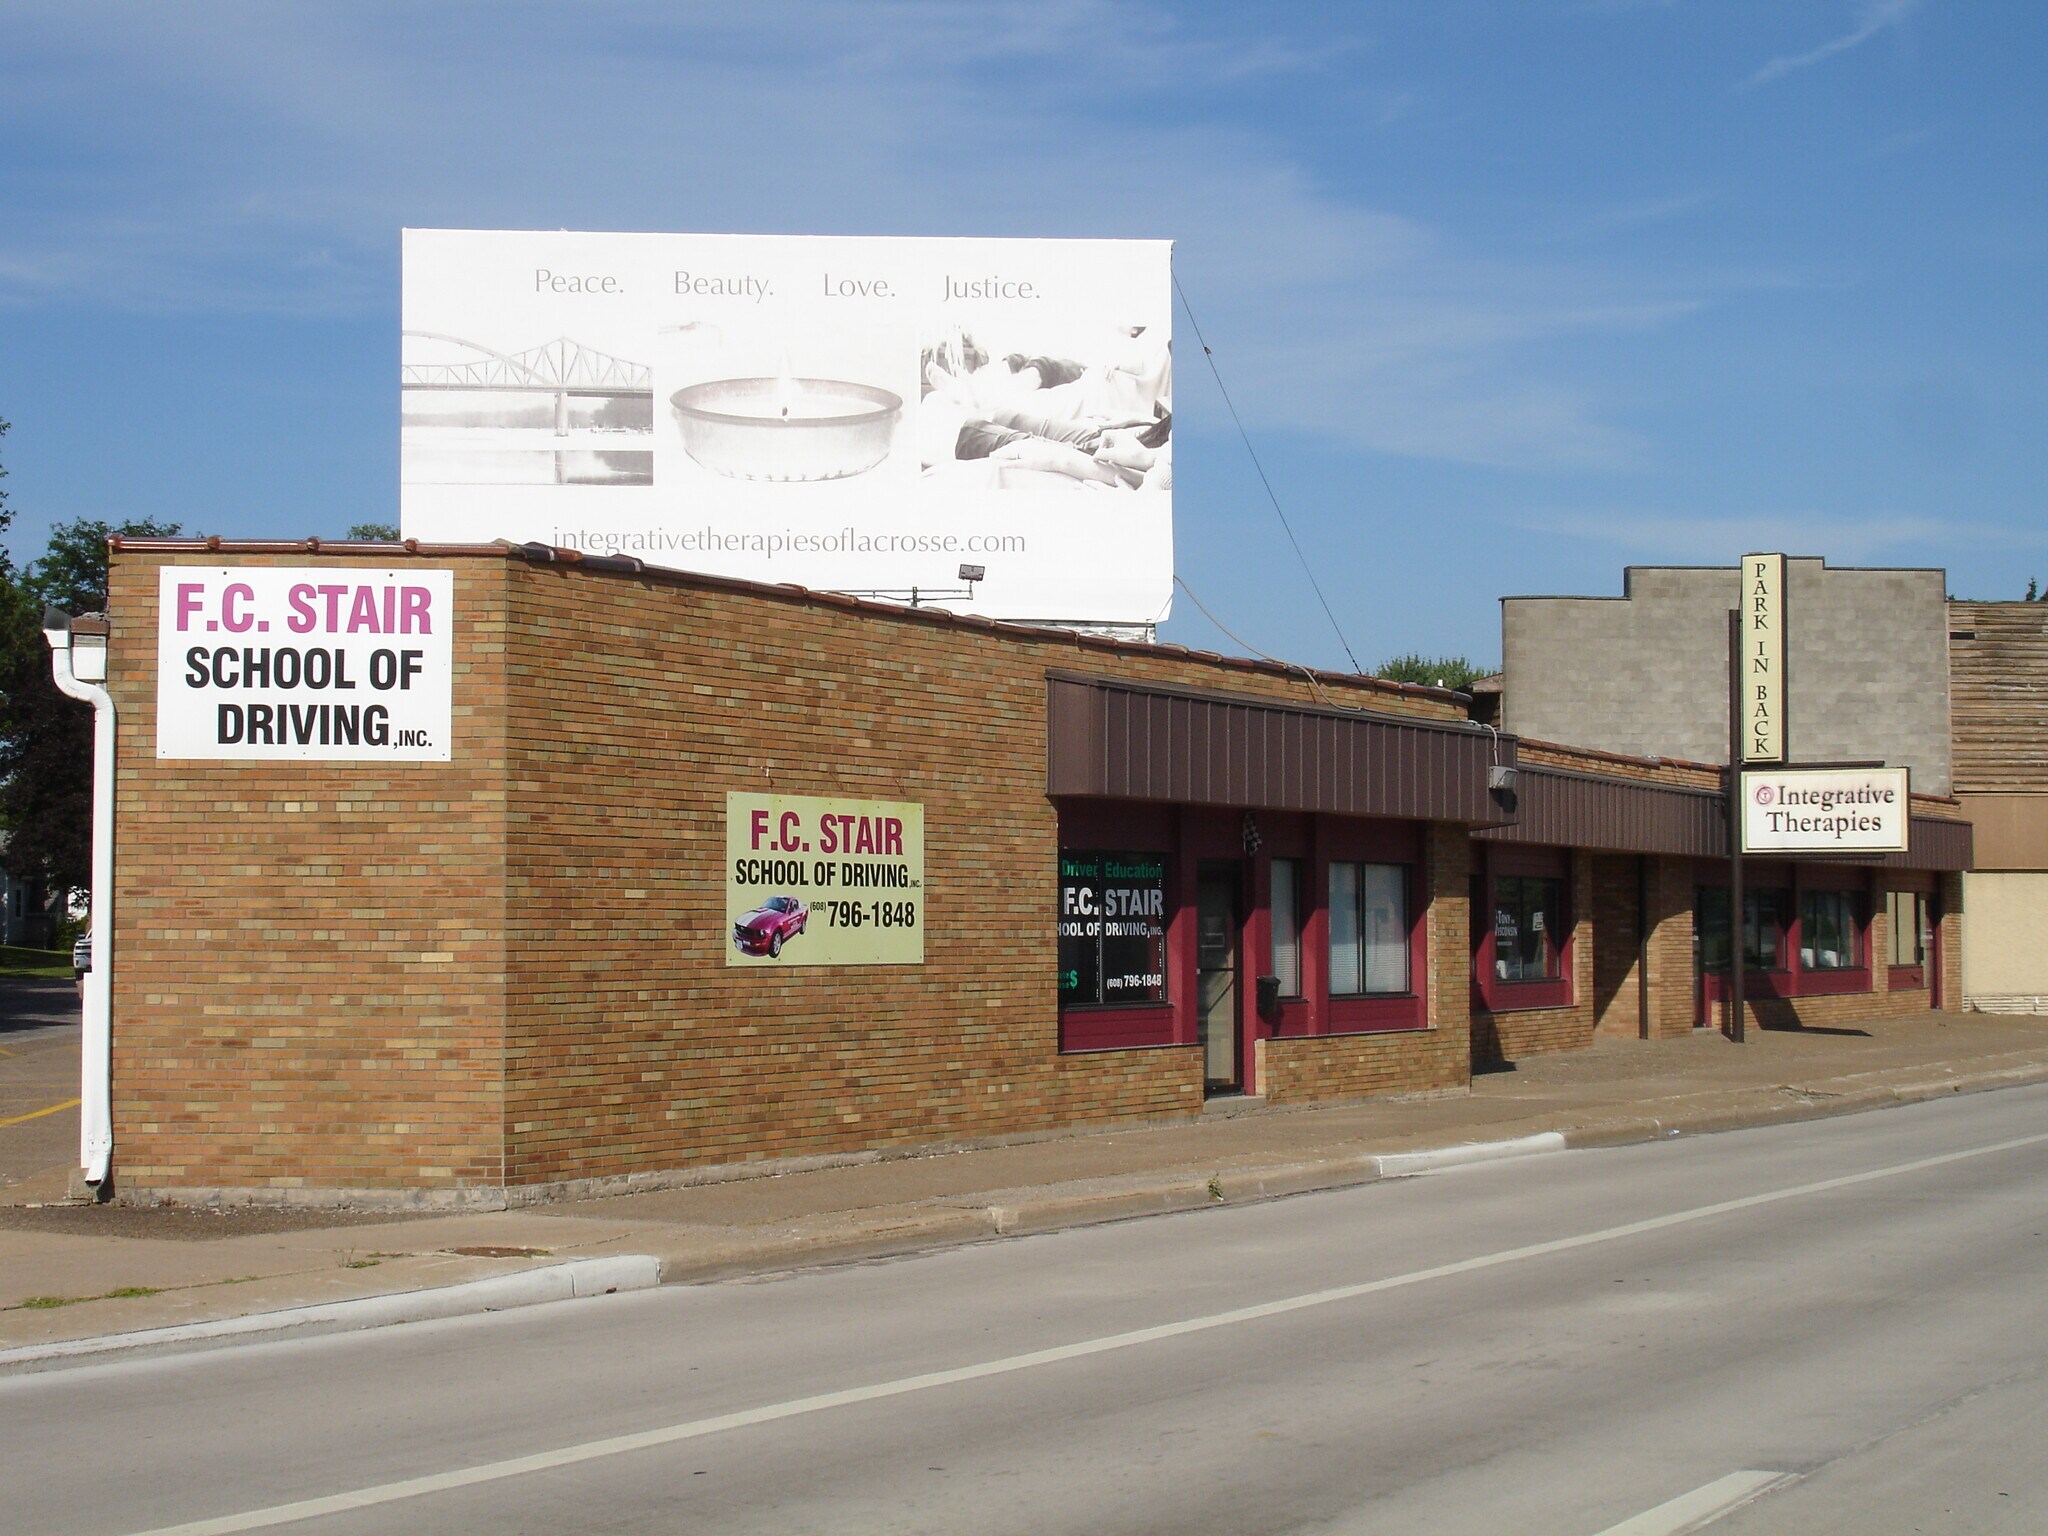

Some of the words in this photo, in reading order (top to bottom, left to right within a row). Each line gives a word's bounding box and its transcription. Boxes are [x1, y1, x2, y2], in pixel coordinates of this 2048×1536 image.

[535, 269, 624, 293] Peace.
[674, 271, 774, 303] Beauty.
[824, 273, 896, 297] Love.
[943, 275, 1041, 302] Justice.
[553, 526, 1027, 559] integrativetherapiesoflacrosse.com
[176, 583, 270, 633] F.C.
[287, 583, 433, 634] STAIR
[1753, 563, 1769, 629] PARK
[185, 646, 357, 689] SCHOOL
[369, 648, 424, 690] OF
[1753, 641, 1770, 673] IN
[217, 703, 390, 747] DRIVING
[1754, 685, 1770, 753] BACK
[1777, 784, 1894, 812] Integrative
[751, 810, 810, 852] F.C.
[820, 813, 904, 855] STAIR
[1766, 810, 1882, 839] Therapies
[735, 859, 809, 886] SCHOOL
[814, 861, 836, 886] OF
[841, 862, 908, 888] DRIVING
[1061, 860, 1098, 877] Driver
[1105, 862, 1163, 878] Education
[827, 901, 916, 928] 796-1848
[1063, 887, 1099, 915] F.C.
[1105, 889, 1164, 916] STAIR
[1086, 922, 1101, 936] OF
[1123, 974, 1162, 987] 796-1848
